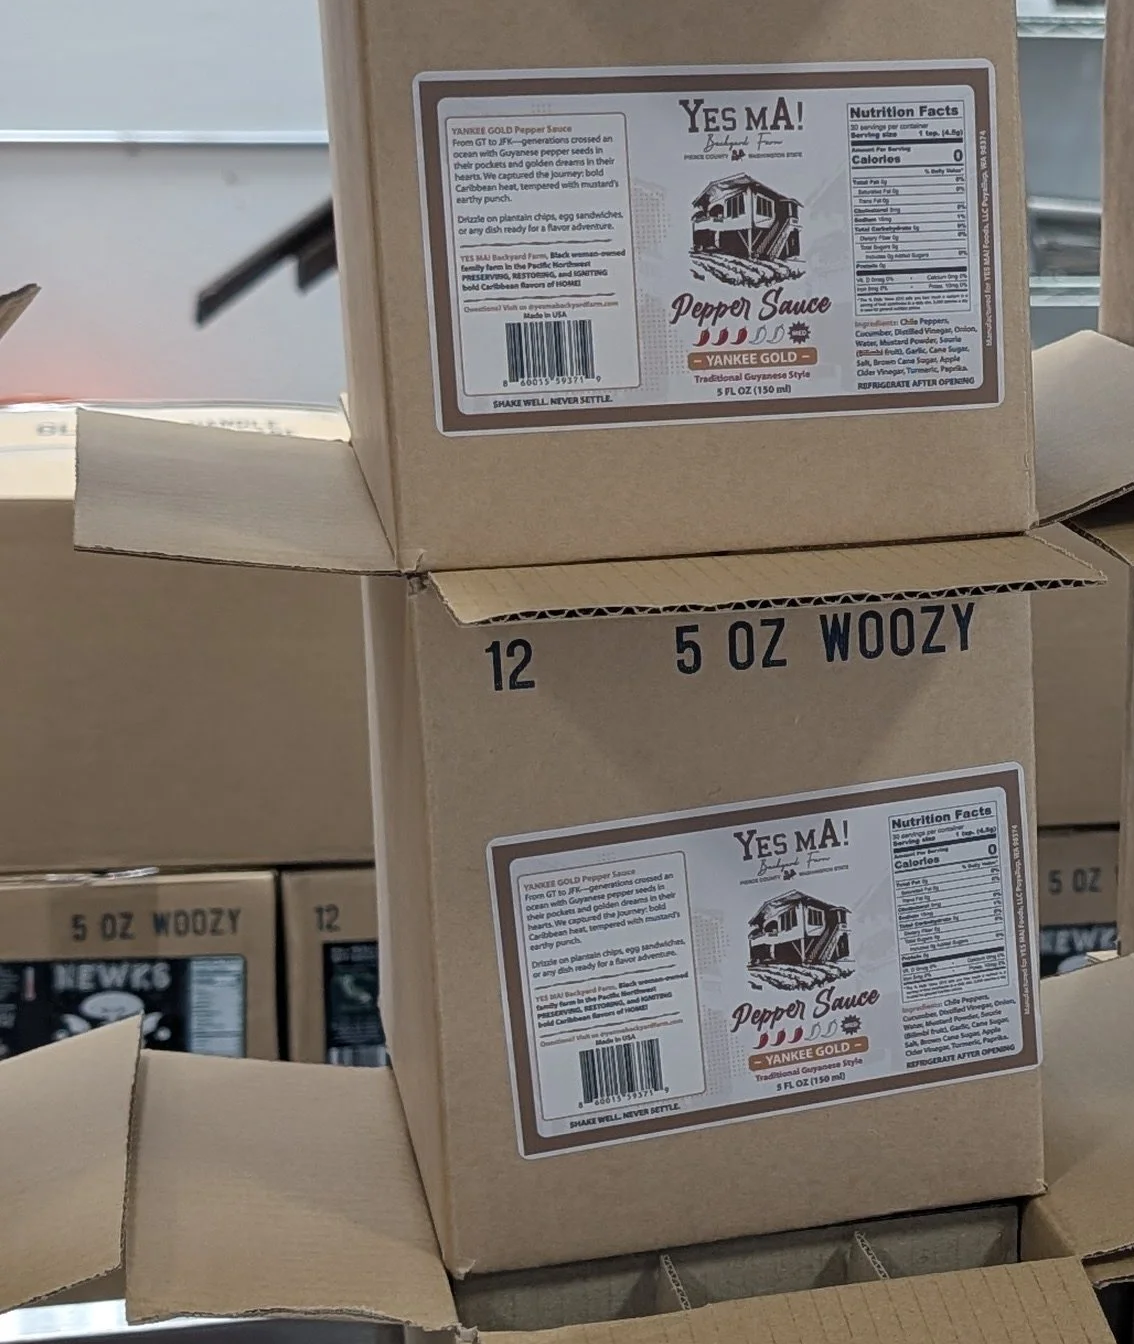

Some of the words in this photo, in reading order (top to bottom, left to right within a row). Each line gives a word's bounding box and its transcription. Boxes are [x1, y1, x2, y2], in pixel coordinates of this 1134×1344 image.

[678, 98, 737, 133] YES
[850, 106, 914, 119] Nutrition
[918, 105, 959, 117] Facts
[851, 154, 901, 165] Calories
[953, 148, 963, 162] 0
[457, 215, 485, 224] Drizzle
[498, 213, 533, 224] plantain
[533, 212, 557, 222] chips,
[558, 213, 574, 222] egg
[575, 210, 624, 220] sandwiches,
[668, 292, 751, 327] Pepper
[756, 286, 832, 321] Sauce
[705, 352, 757, 366] YANKEE
[759, 351, 797, 364] GOLD
[493, 399, 522, 409] SHAKE
[523, 398, 549, 407] WELL.
[550, 396, 579, 405] NEVER
[580, 395, 613, 404] SETTLE.
[484, 638, 536, 692] 12
[675, 624, 702, 675] 5
[728, 618, 787, 671] OZ
[819, 602, 976, 663] WOOZY
[891, 813, 951, 830] Nutrition
[954, 806, 992, 820] Facts
[733, 828, 787, 861] YES
[894, 856, 940, 870] Calories
[987, 843, 997, 855] 0
[1048, 869, 1063, 895] 5
[1071, 867, 1102, 893] OZ
[71, 913, 87, 942] 5
[100, 911, 136, 941] OZ
[153, 907, 242, 936] WOOZY
[314, 904, 341, 932] 12
[730, 999, 806, 1033] Pepper
[810, 985, 880, 1019] Sauce
[765, 1047, 813, 1065] YANKEE
[815, 1042, 850, 1057] GOLD
[755, 1067, 800, 1082] Traditional
[801, 1061, 841, 1074] Guyanese
[842, 1057, 863, 1067] Style
